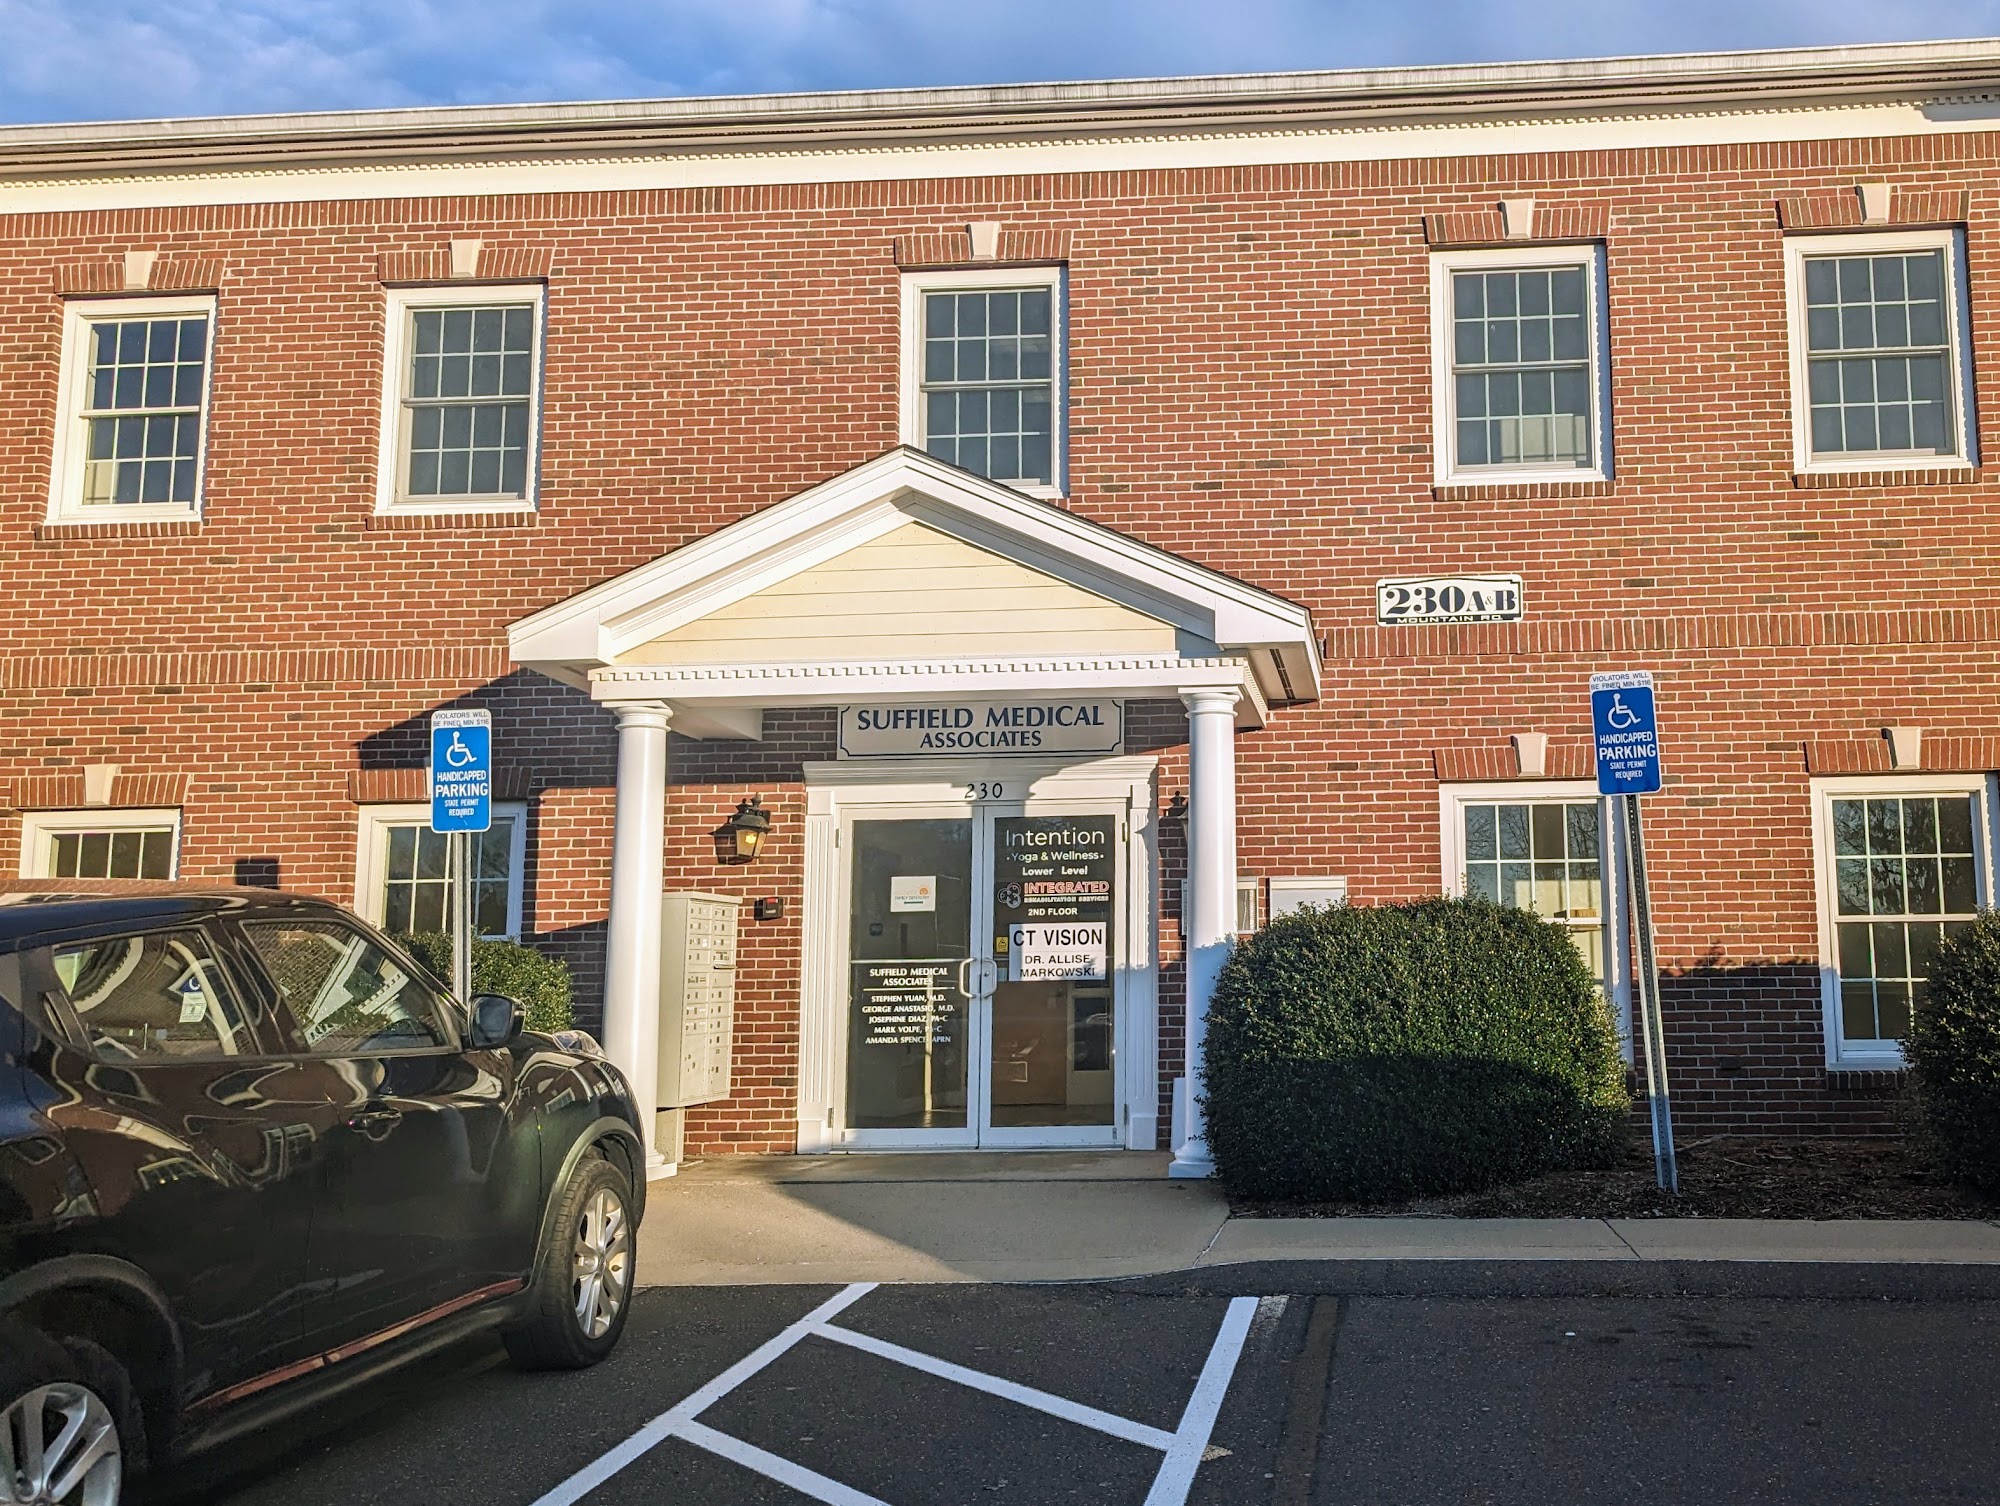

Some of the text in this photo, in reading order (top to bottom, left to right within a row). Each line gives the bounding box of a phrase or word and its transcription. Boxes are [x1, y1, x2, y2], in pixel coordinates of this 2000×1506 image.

[1397, 616, 1473, 624] MOUNTAIN
[1592, 674, 1629, 682] VIOLATORS
[858, 704, 1105, 730] SUFFIELD MEDICAL
[920, 730, 1043, 748] ASSOCIATES
[1600, 731, 1653, 745] HANDICAPPED
[1599, 744, 1656, 760] PARKING
[1627, 760, 1647, 768] PERMIT
[437, 770, 486, 782] HANDICAPPED
[1616, 769, 1643, 779] REQUIRED
[436, 783, 488, 797] PARKING
[964, 783, 1003, 798] 230
[444, 799, 459, 807] STATE
[449, 808, 474, 816] REQUIRED
[1006, 827, 1105, 846] Intention
[1012, 851, 1099, 863] Yoga & Wellness
[1022, 866, 1088, 876] Lower Level
[1024, 881, 1109, 893] INTEGRATED
[1014, 929, 1102, 946] CT VISION
[1025, 955, 1090, 964] DR. ALLISE
[870, 968, 907, 976] SUFFIELD
[1020, 968, 1095, 977] MARKOWSKI
[883, 978, 933, 986] ASSOCIATES
[868, 1016, 906, 1024] JOSEPHINE
[898, 1026, 922, 1034] VOLPE,
